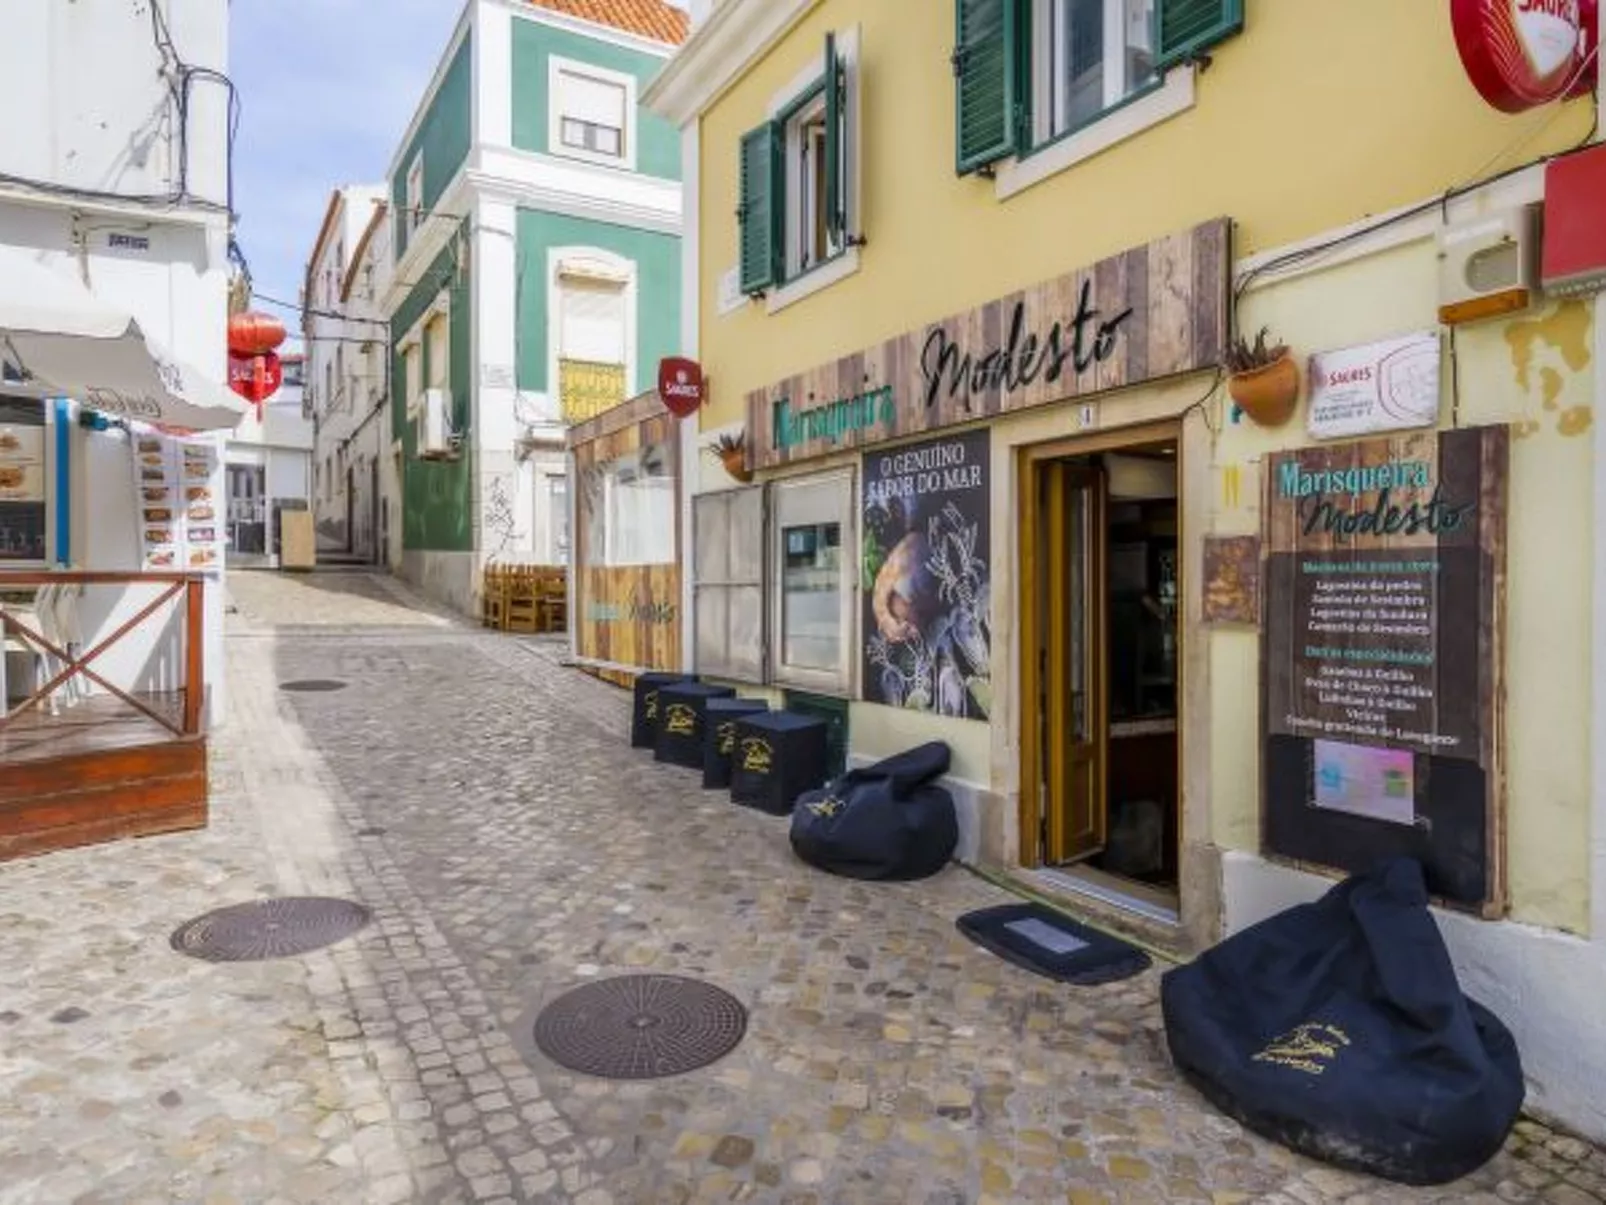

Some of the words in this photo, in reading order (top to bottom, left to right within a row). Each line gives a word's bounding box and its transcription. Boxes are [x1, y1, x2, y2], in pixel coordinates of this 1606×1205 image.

[922, 279, 1132, 411] Modesto
[772, 376, 896, 449] Marisqueira
[880, 457, 892, 477] O
[893, 441, 965, 475] GENUÍNO
[917, 471, 940, 494] DO
[943, 464, 982, 491] MAR
[1279, 457, 1429, 499] Marisqueira
[1302, 485, 1475, 543] Modesto
